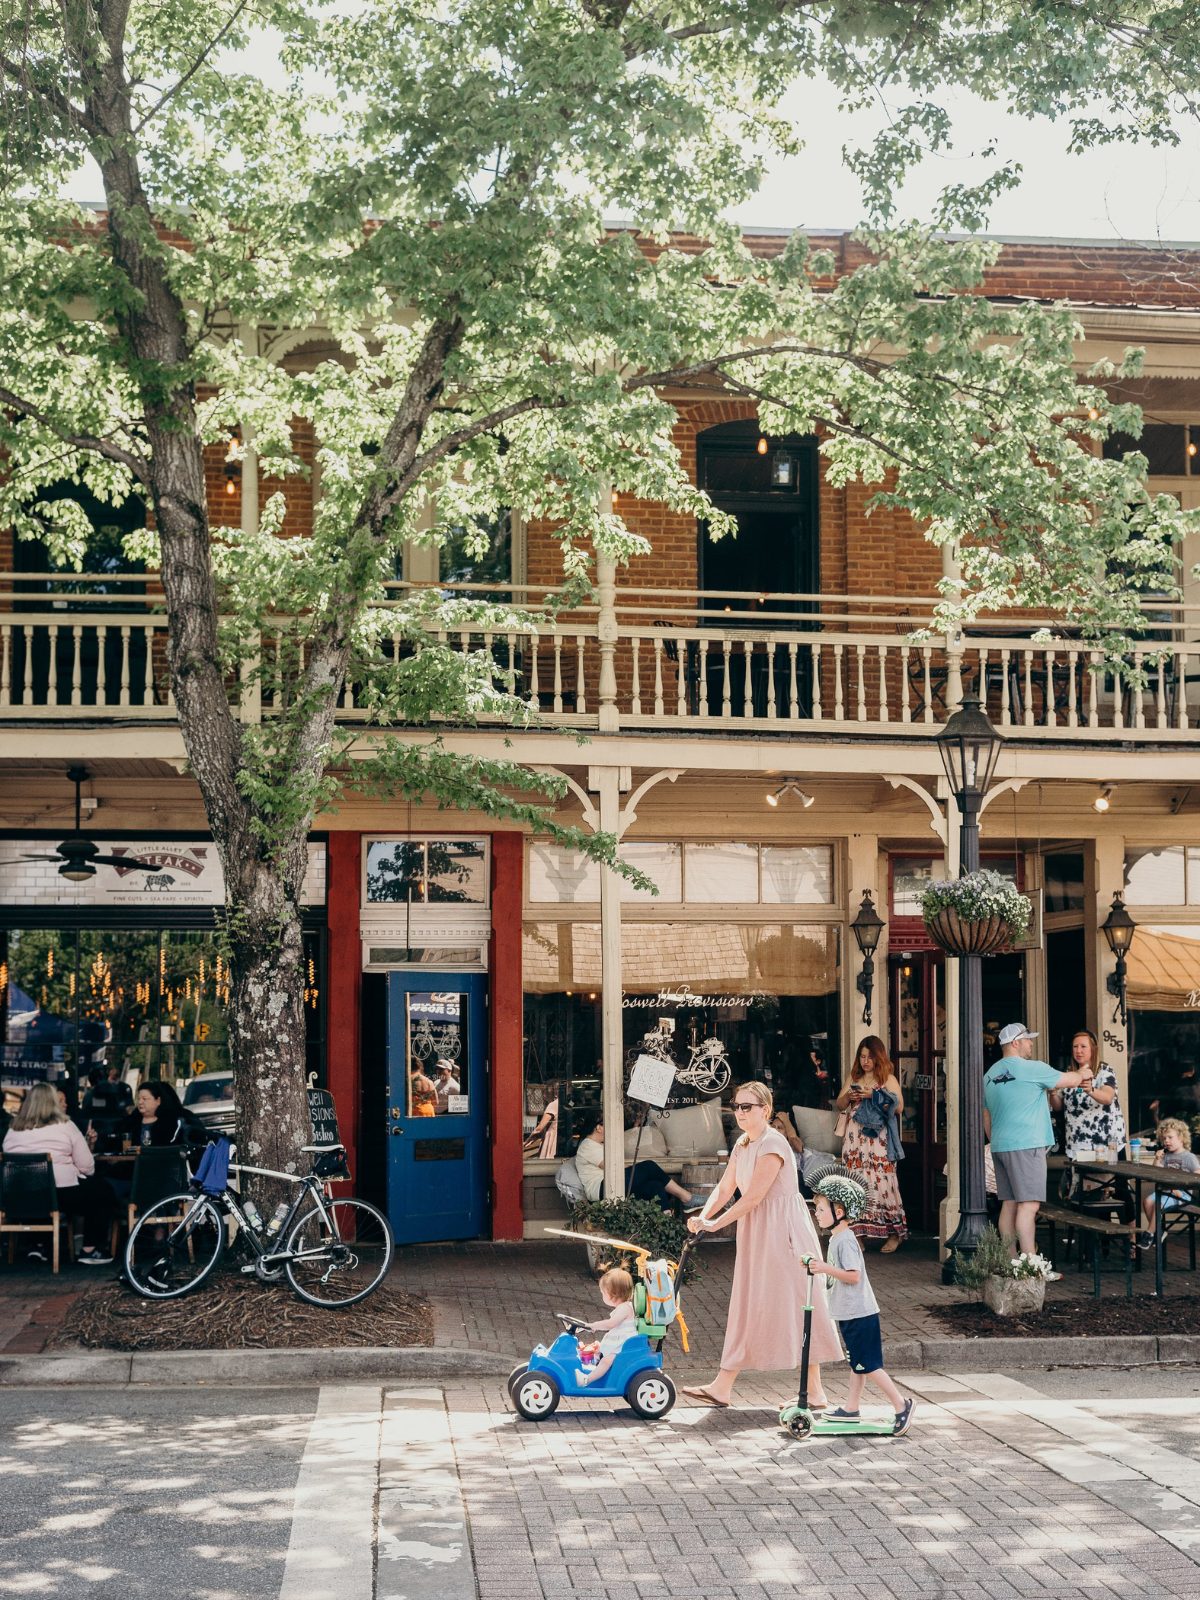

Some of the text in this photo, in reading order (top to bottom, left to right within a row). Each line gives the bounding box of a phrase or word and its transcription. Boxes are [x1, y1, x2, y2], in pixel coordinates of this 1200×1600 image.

[162, 845, 183, 853] ALLEY
[136, 856, 184, 868] TEAK
[622, 984, 754, 1009] oswell Provisions
[1103, 1030, 1124, 1052] 955
[916, 1075, 932, 1088] OPEN
[308, 1092, 324, 1107] well
